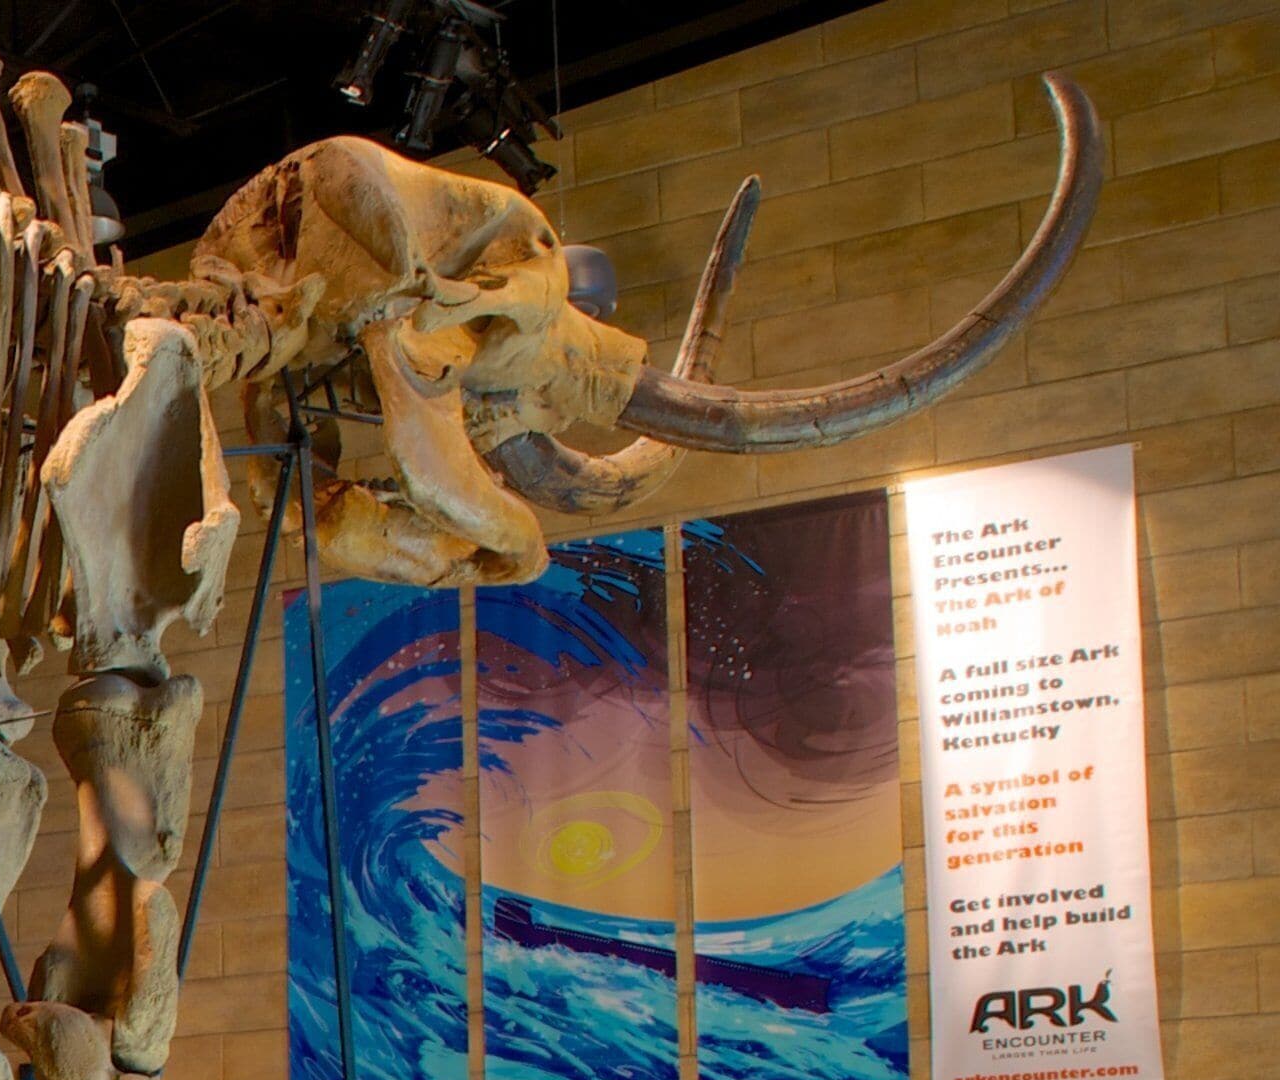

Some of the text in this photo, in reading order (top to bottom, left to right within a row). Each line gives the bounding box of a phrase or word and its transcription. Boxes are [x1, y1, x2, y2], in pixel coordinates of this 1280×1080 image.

[931, 518, 1029, 546] The Ark
[933, 537, 1062, 569] Encounter
[934, 562, 1068, 591] Presents...
[934, 580, 1066, 614] The Ark of
[936, 616, 997, 637] Noah
[939, 644, 1120, 682] A full size Ark
[940, 677, 1063, 706] coming to
[942, 724, 1061, 752] Kentucky
[944, 765, 1095, 798] A symbol of
[944, 796, 1057, 822] salvation
[945, 820, 1039, 845] for this
[947, 840, 1084, 870] generation
[949, 884, 1105, 914] Get involved
[950, 904, 1132, 938] and help build
[952, 938, 1047, 961] the Ark
[969, 979, 1119, 1034] ARK
[982, 1030, 1107, 1051] ENCOUNTER
